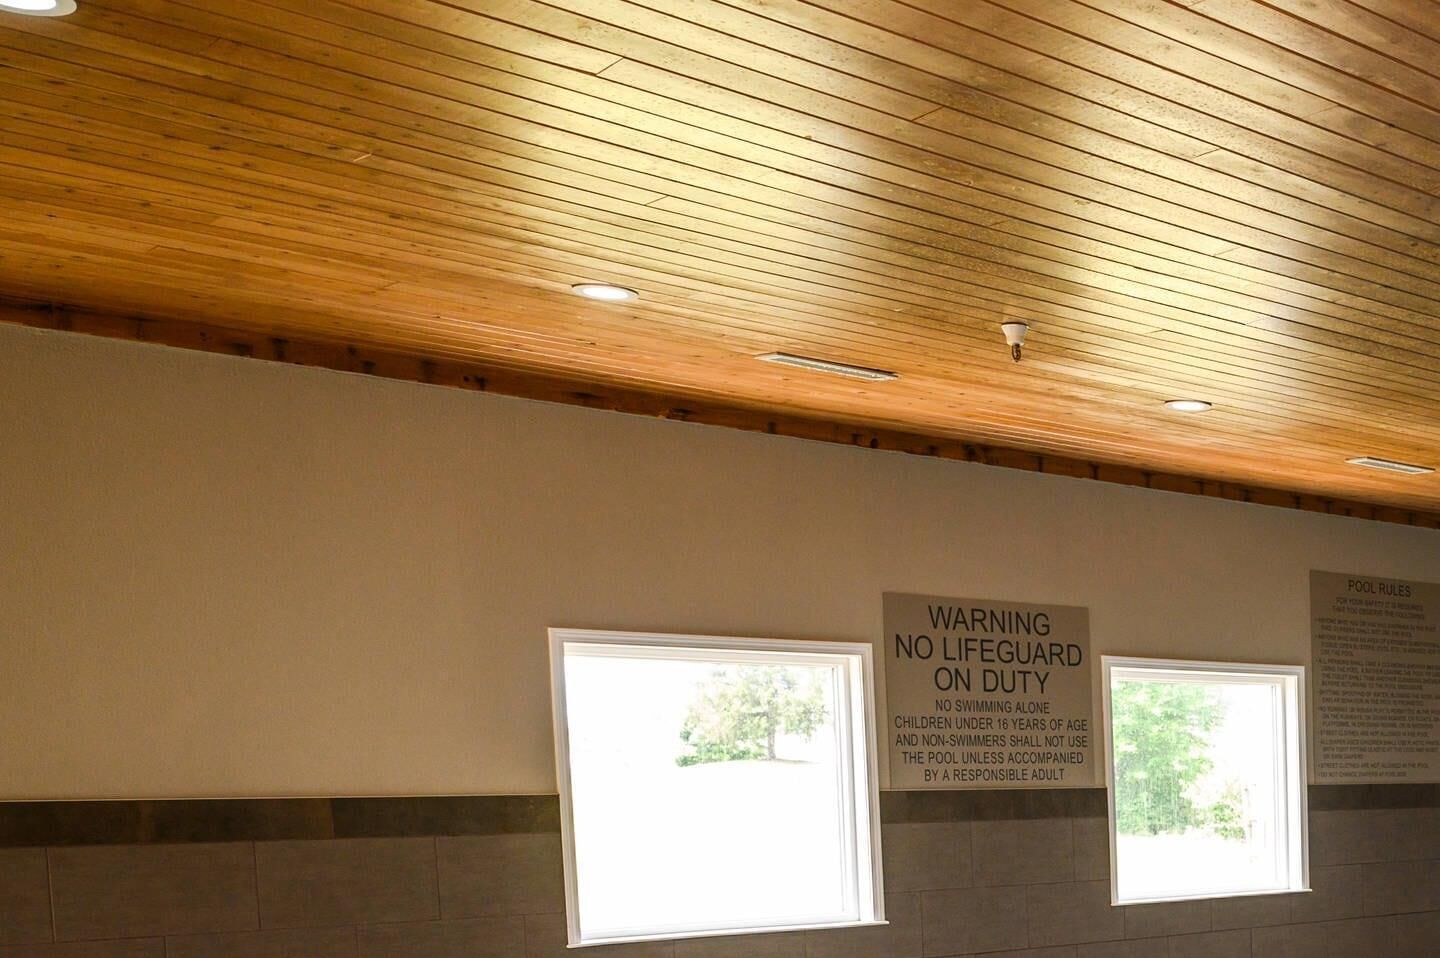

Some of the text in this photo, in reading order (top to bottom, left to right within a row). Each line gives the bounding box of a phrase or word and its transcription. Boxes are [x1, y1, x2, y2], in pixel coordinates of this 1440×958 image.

[1348, 579, 1411, 597] POOL RULES
[928, 605, 1050, 636] WARNING
[895, 634, 1082, 667] NO LIFEGUARD
[934, 667, 1050, 694] ON DUTY
[935, 699, 1050, 714] NO SWIMMING ALONE
[895, 716, 952, 729] CHILDREN
[956, 717, 993, 730] UNDER
[1011, 718, 1046, 731] YEARS
[1049, 719, 1064, 731] OF
[1067, 719, 1088, 732] AGE
[896, 734, 1088, 747] AND NON-SWIMMERS SHALL NOT USE
[902, 751, 1084, 764] THE POOL UNLESS ACCOMPANIED
[924, 768, 1064, 781] BY A RESPONSIBLE ADULT
